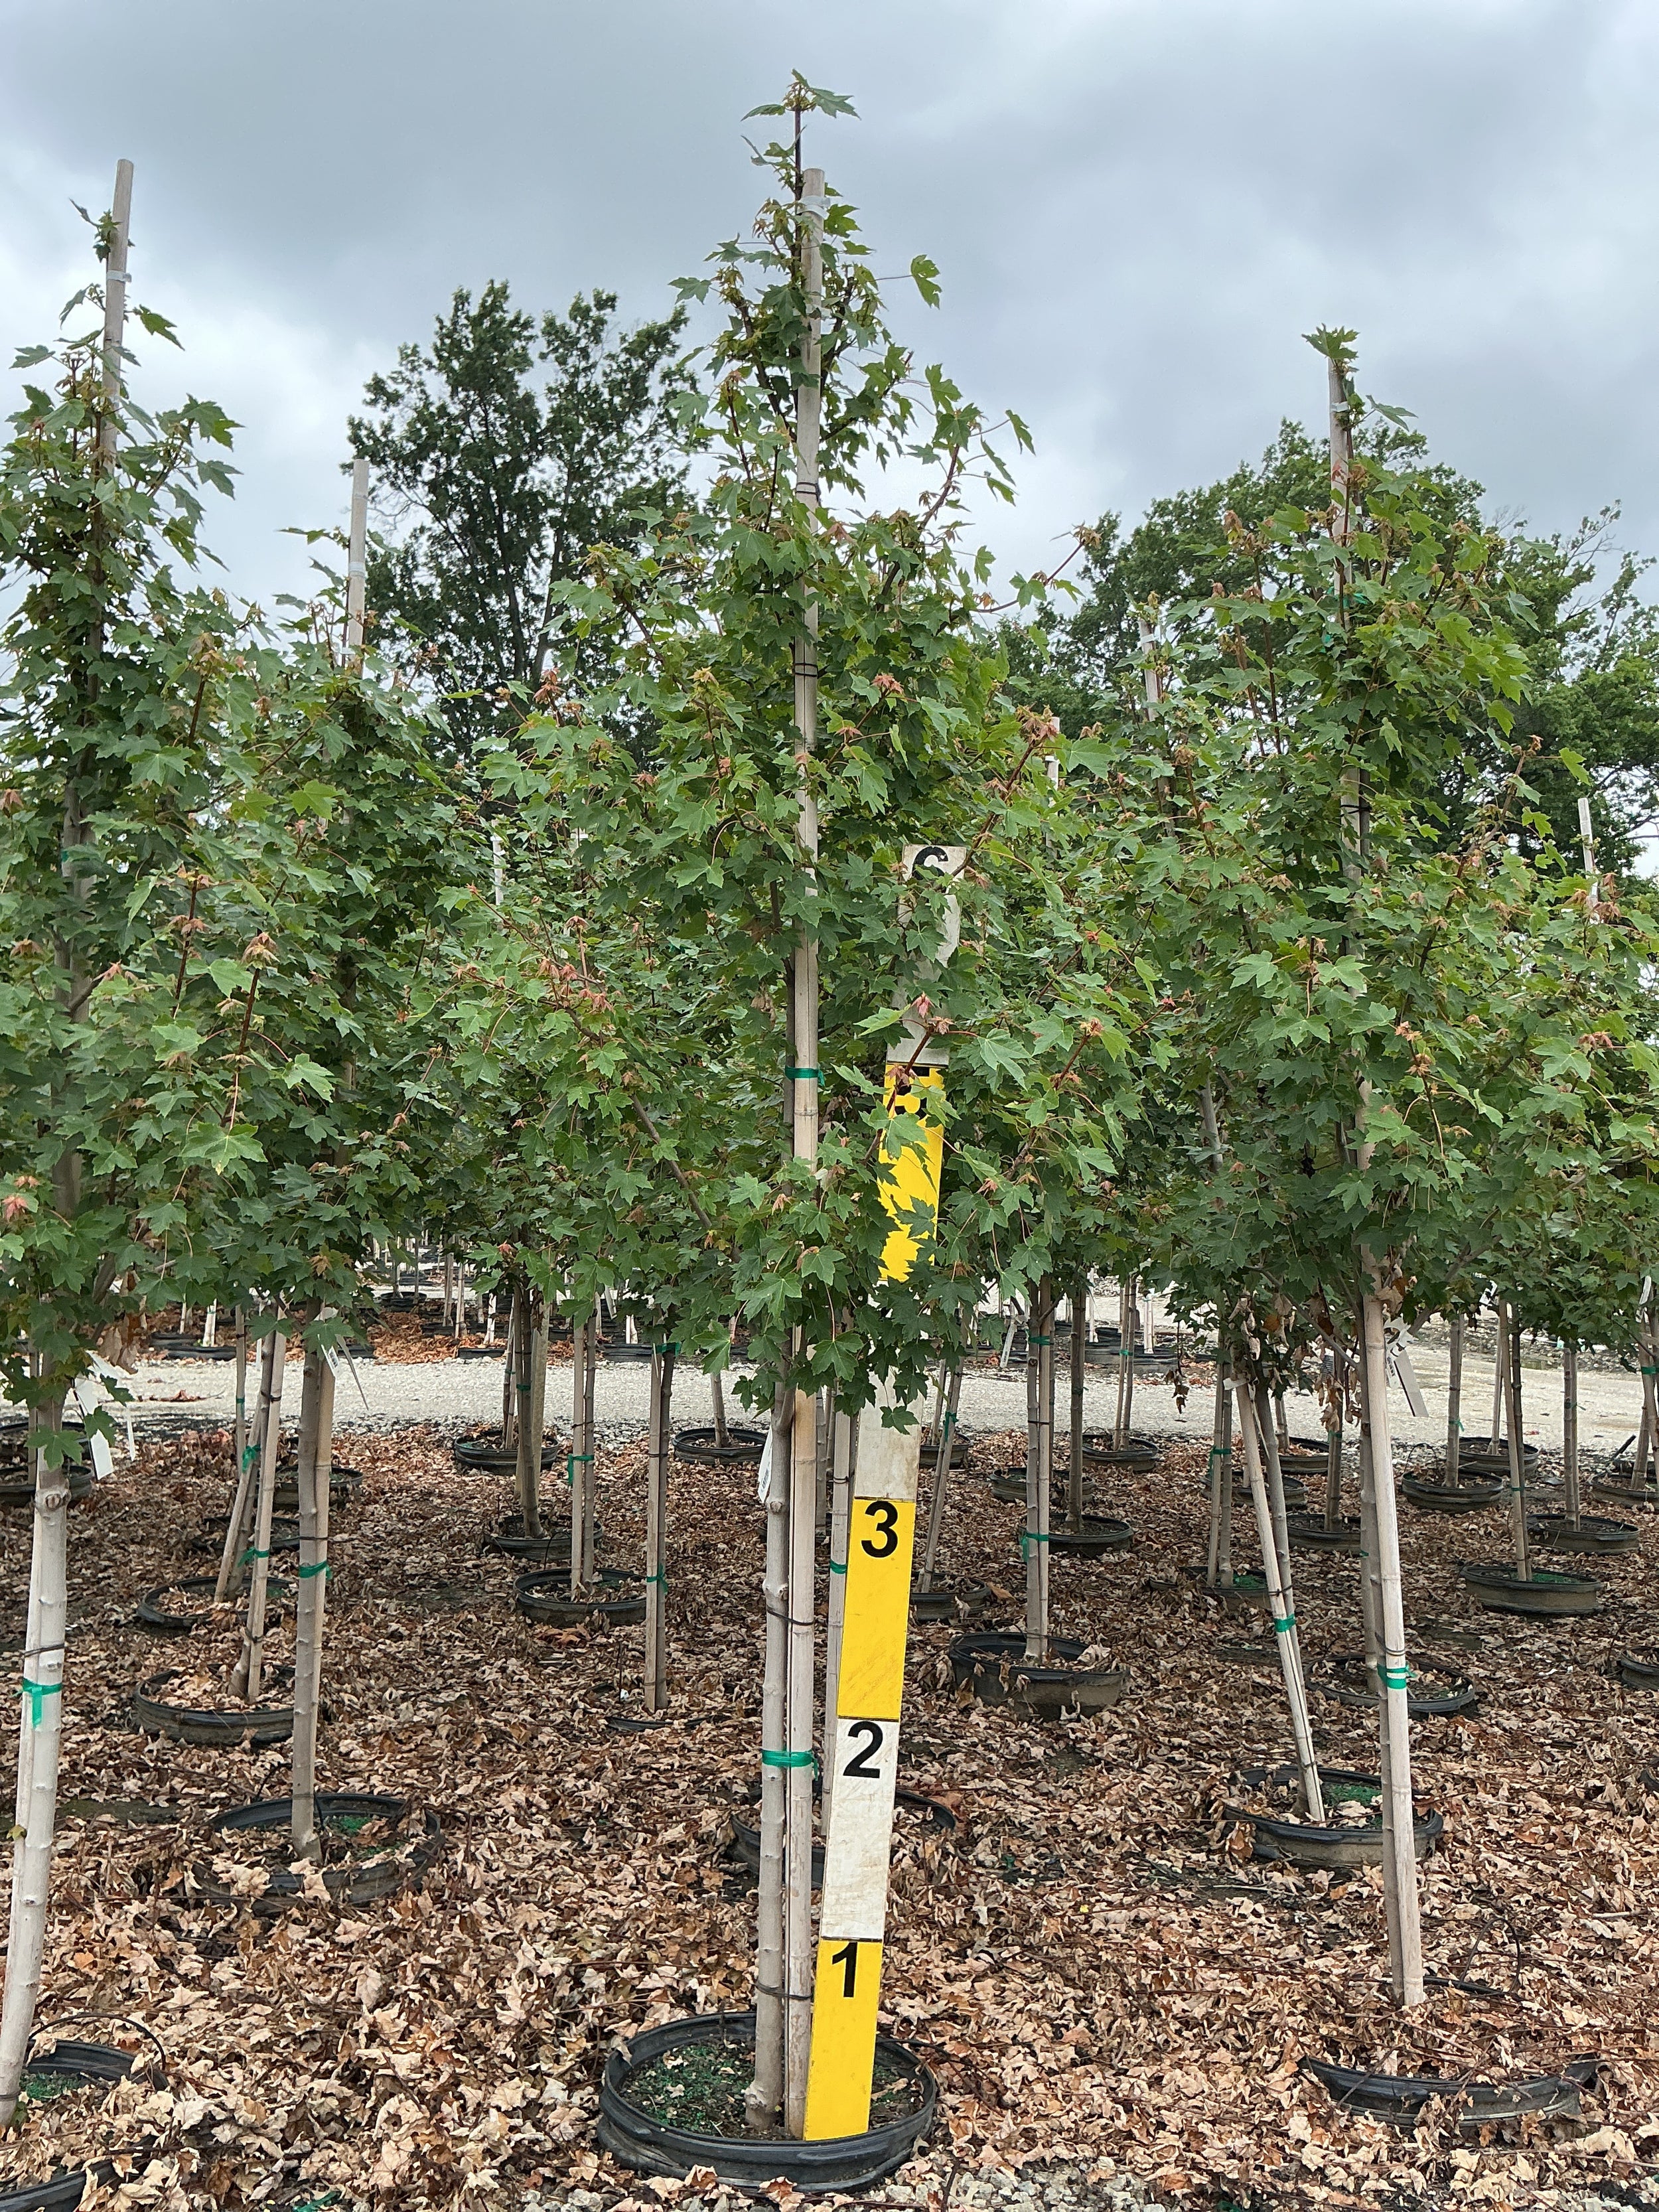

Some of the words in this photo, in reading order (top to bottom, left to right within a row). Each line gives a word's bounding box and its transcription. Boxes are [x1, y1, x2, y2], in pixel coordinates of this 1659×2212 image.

[861, 1501, 899, 1558] 3
[843, 1721, 883, 1779] 2
[831, 1941, 858, 1998] 1
